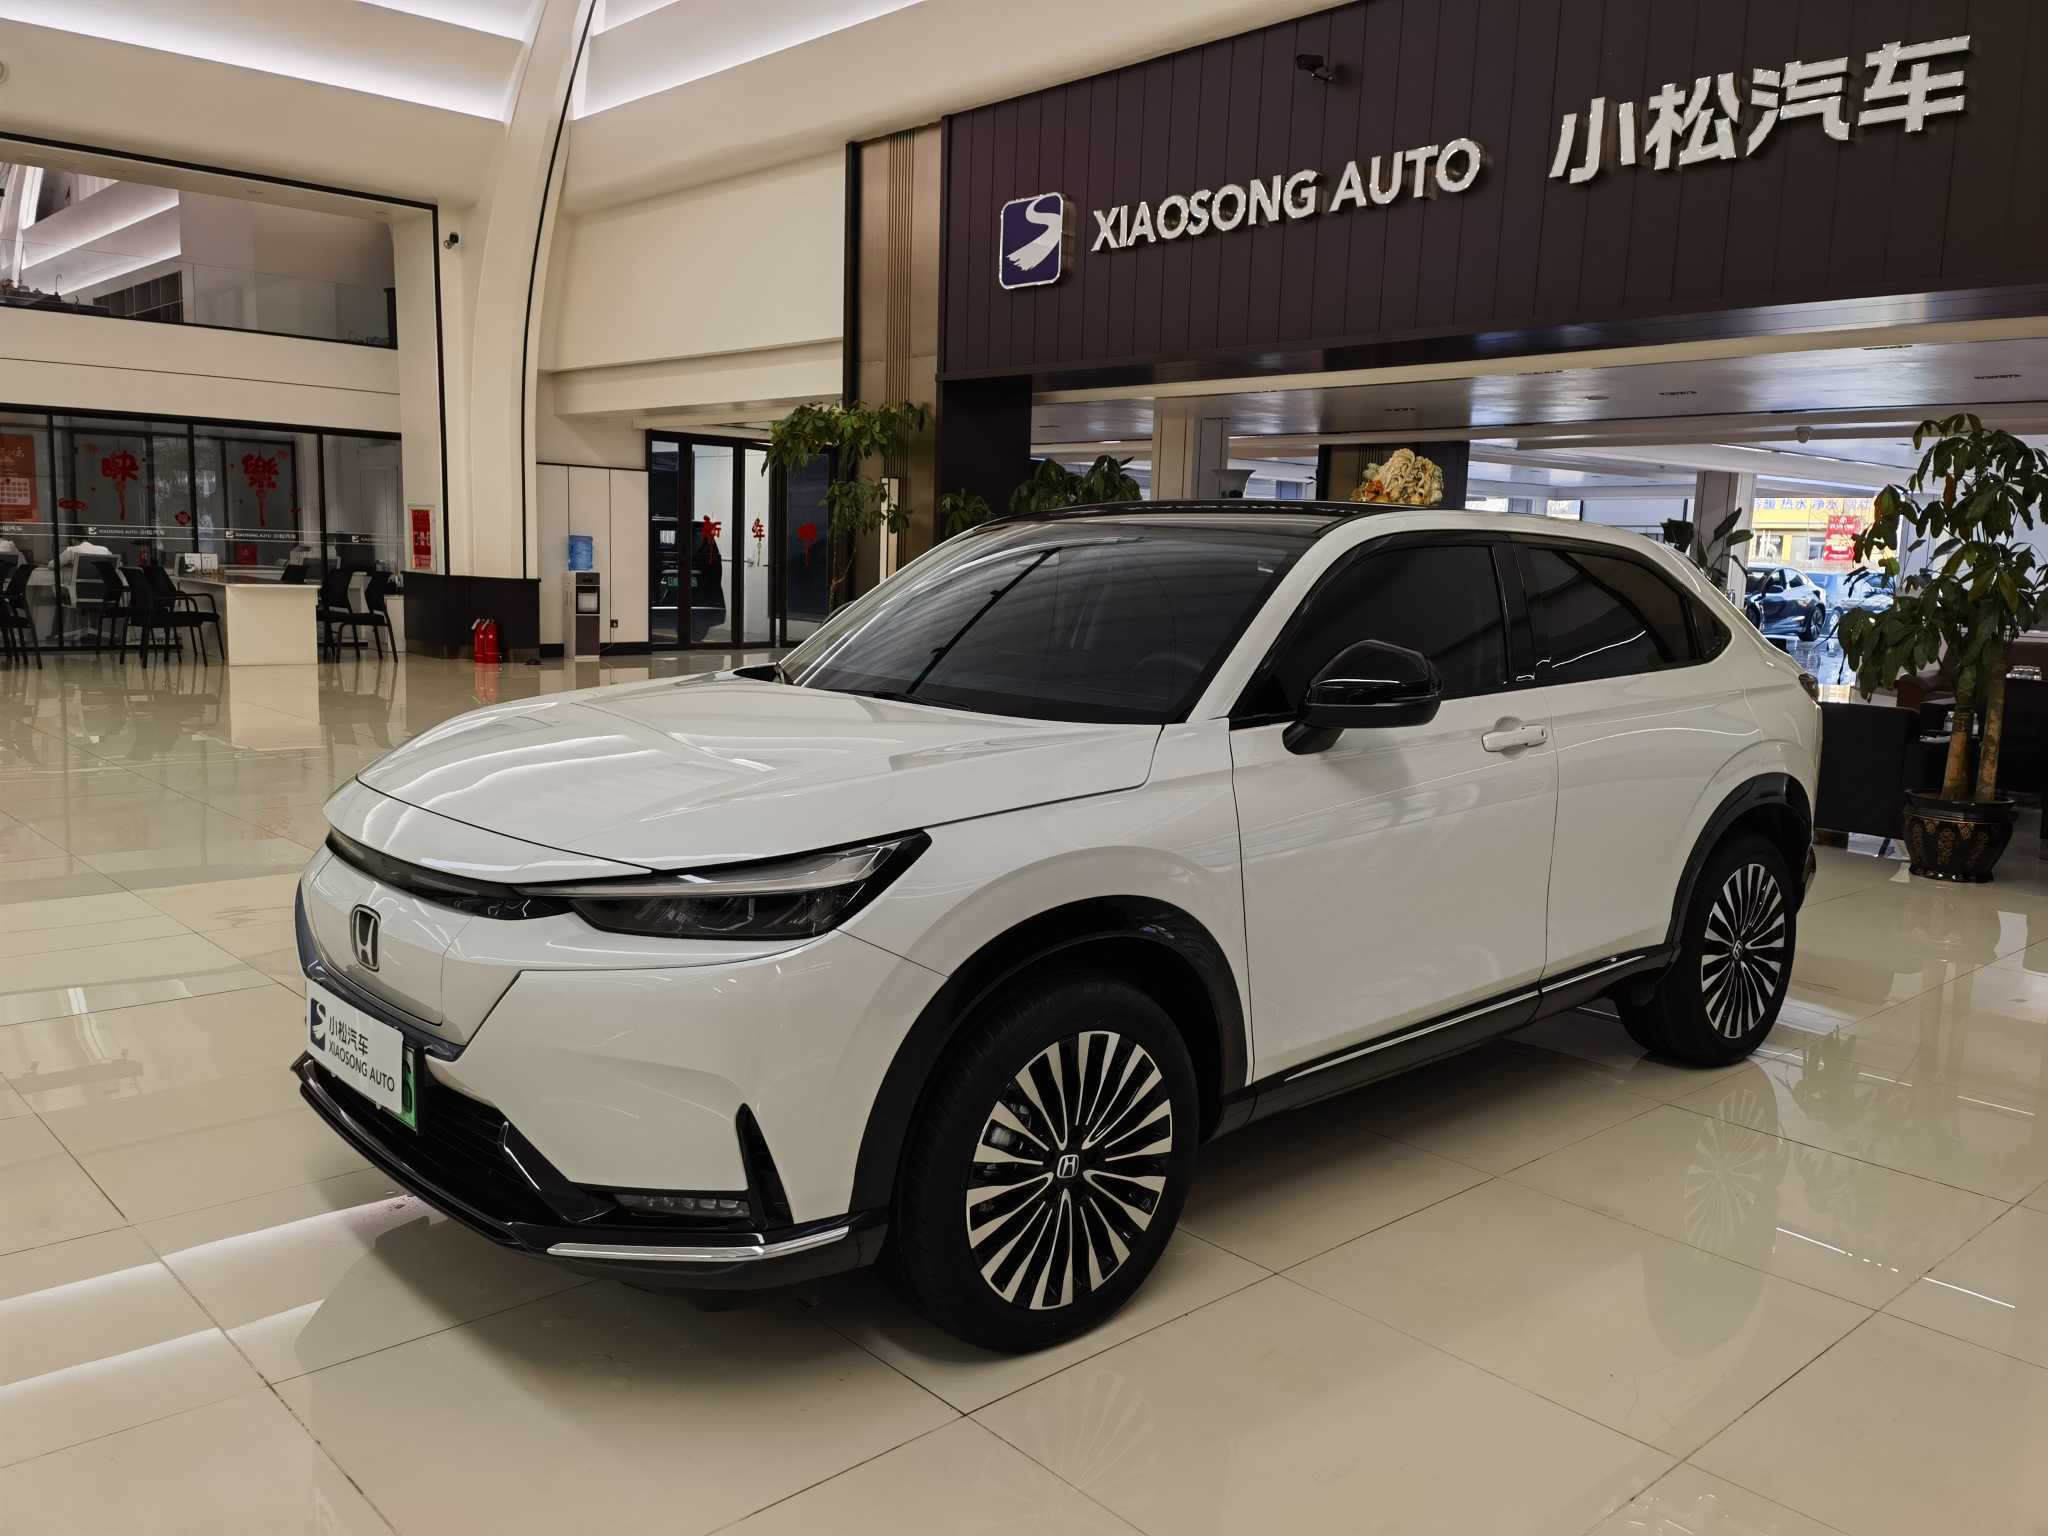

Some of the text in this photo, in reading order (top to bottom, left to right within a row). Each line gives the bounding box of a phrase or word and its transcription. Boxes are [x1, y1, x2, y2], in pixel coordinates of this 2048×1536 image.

[1090, 34, 1972, 252] XIAOSONG AUTO 小松汽车
[328, 1015, 369, 1056] 小松汽车
[328, 1039, 396, 1092] XIAOSONG AUTO
